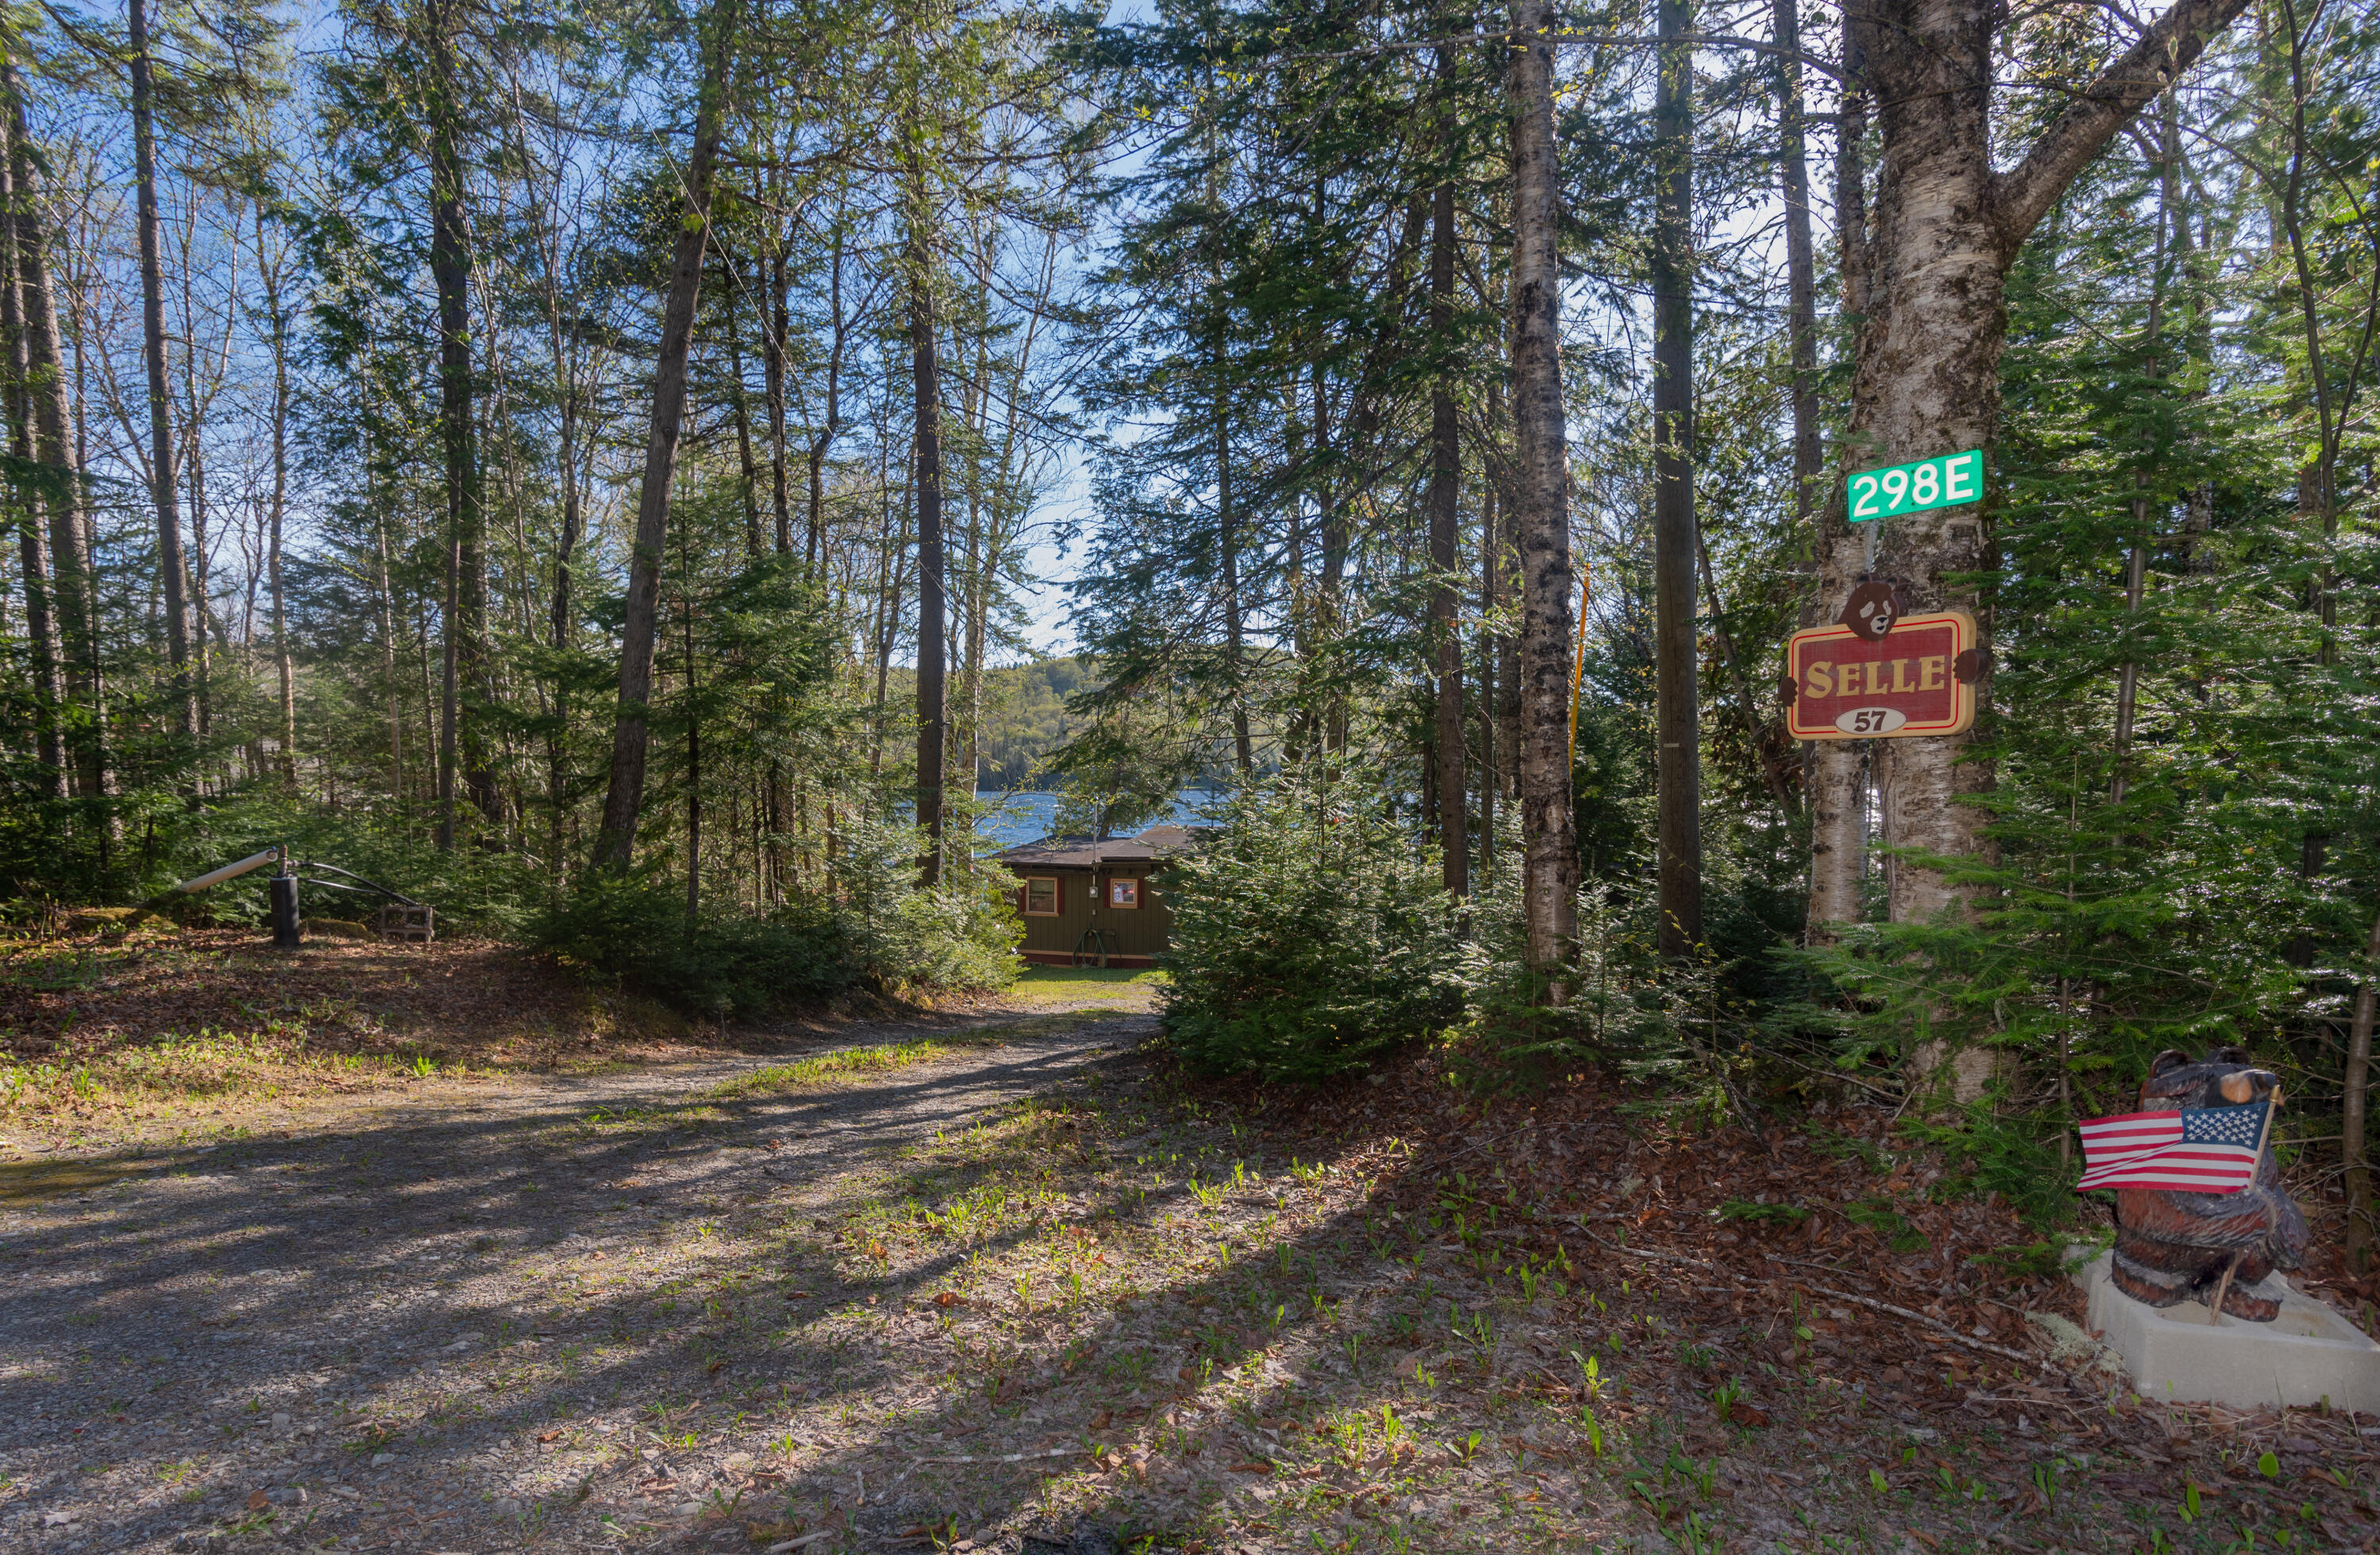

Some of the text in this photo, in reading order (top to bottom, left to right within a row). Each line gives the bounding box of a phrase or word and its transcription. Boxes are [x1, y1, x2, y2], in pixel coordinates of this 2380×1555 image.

[1852, 455, 1974, 517] 298E
[1804, 655, 1946, 699] SELLE
[1854, 710, 1887, 732] 57
